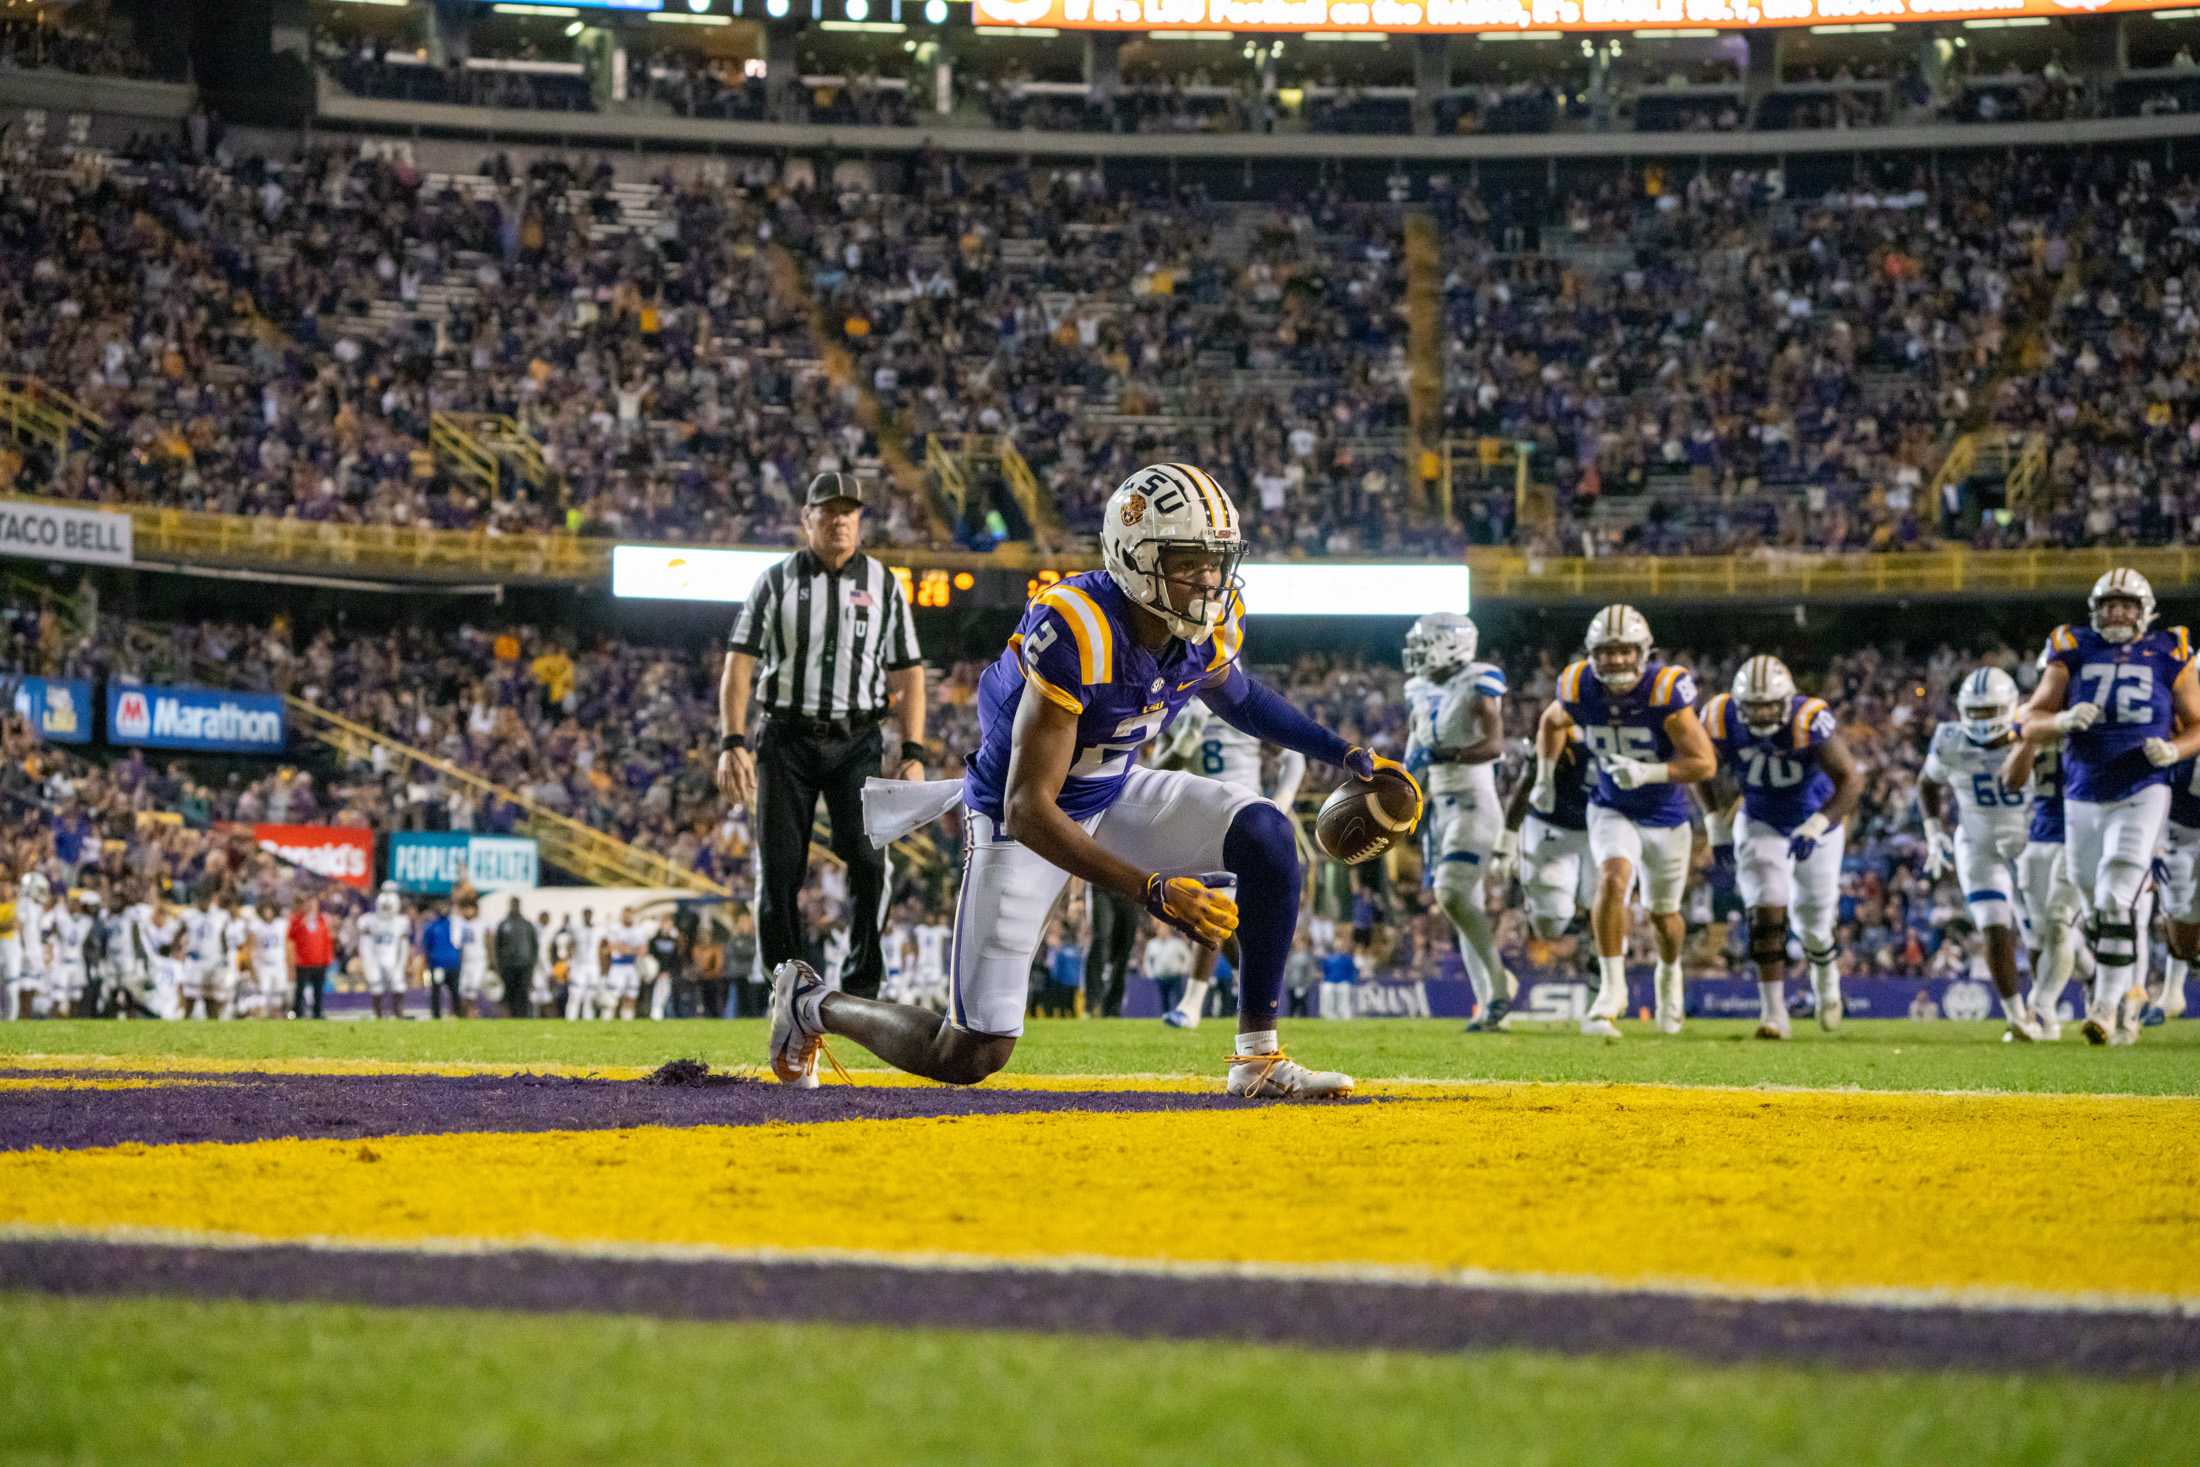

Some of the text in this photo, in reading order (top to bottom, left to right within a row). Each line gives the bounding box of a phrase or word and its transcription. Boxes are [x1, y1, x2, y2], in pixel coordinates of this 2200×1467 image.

[63, 520, 120, 551] BELL
[856, 620, 867, 638] U
[1024, 620, 1058, 666] 2
[2080, 663, 2153, 724] 72
[153, 697, 280, 744] Marathon
[1067, 707, 1169, 779] 2
[1202, 739, 1225, 774] 8
[1737, 746, 1804, 788] 70
